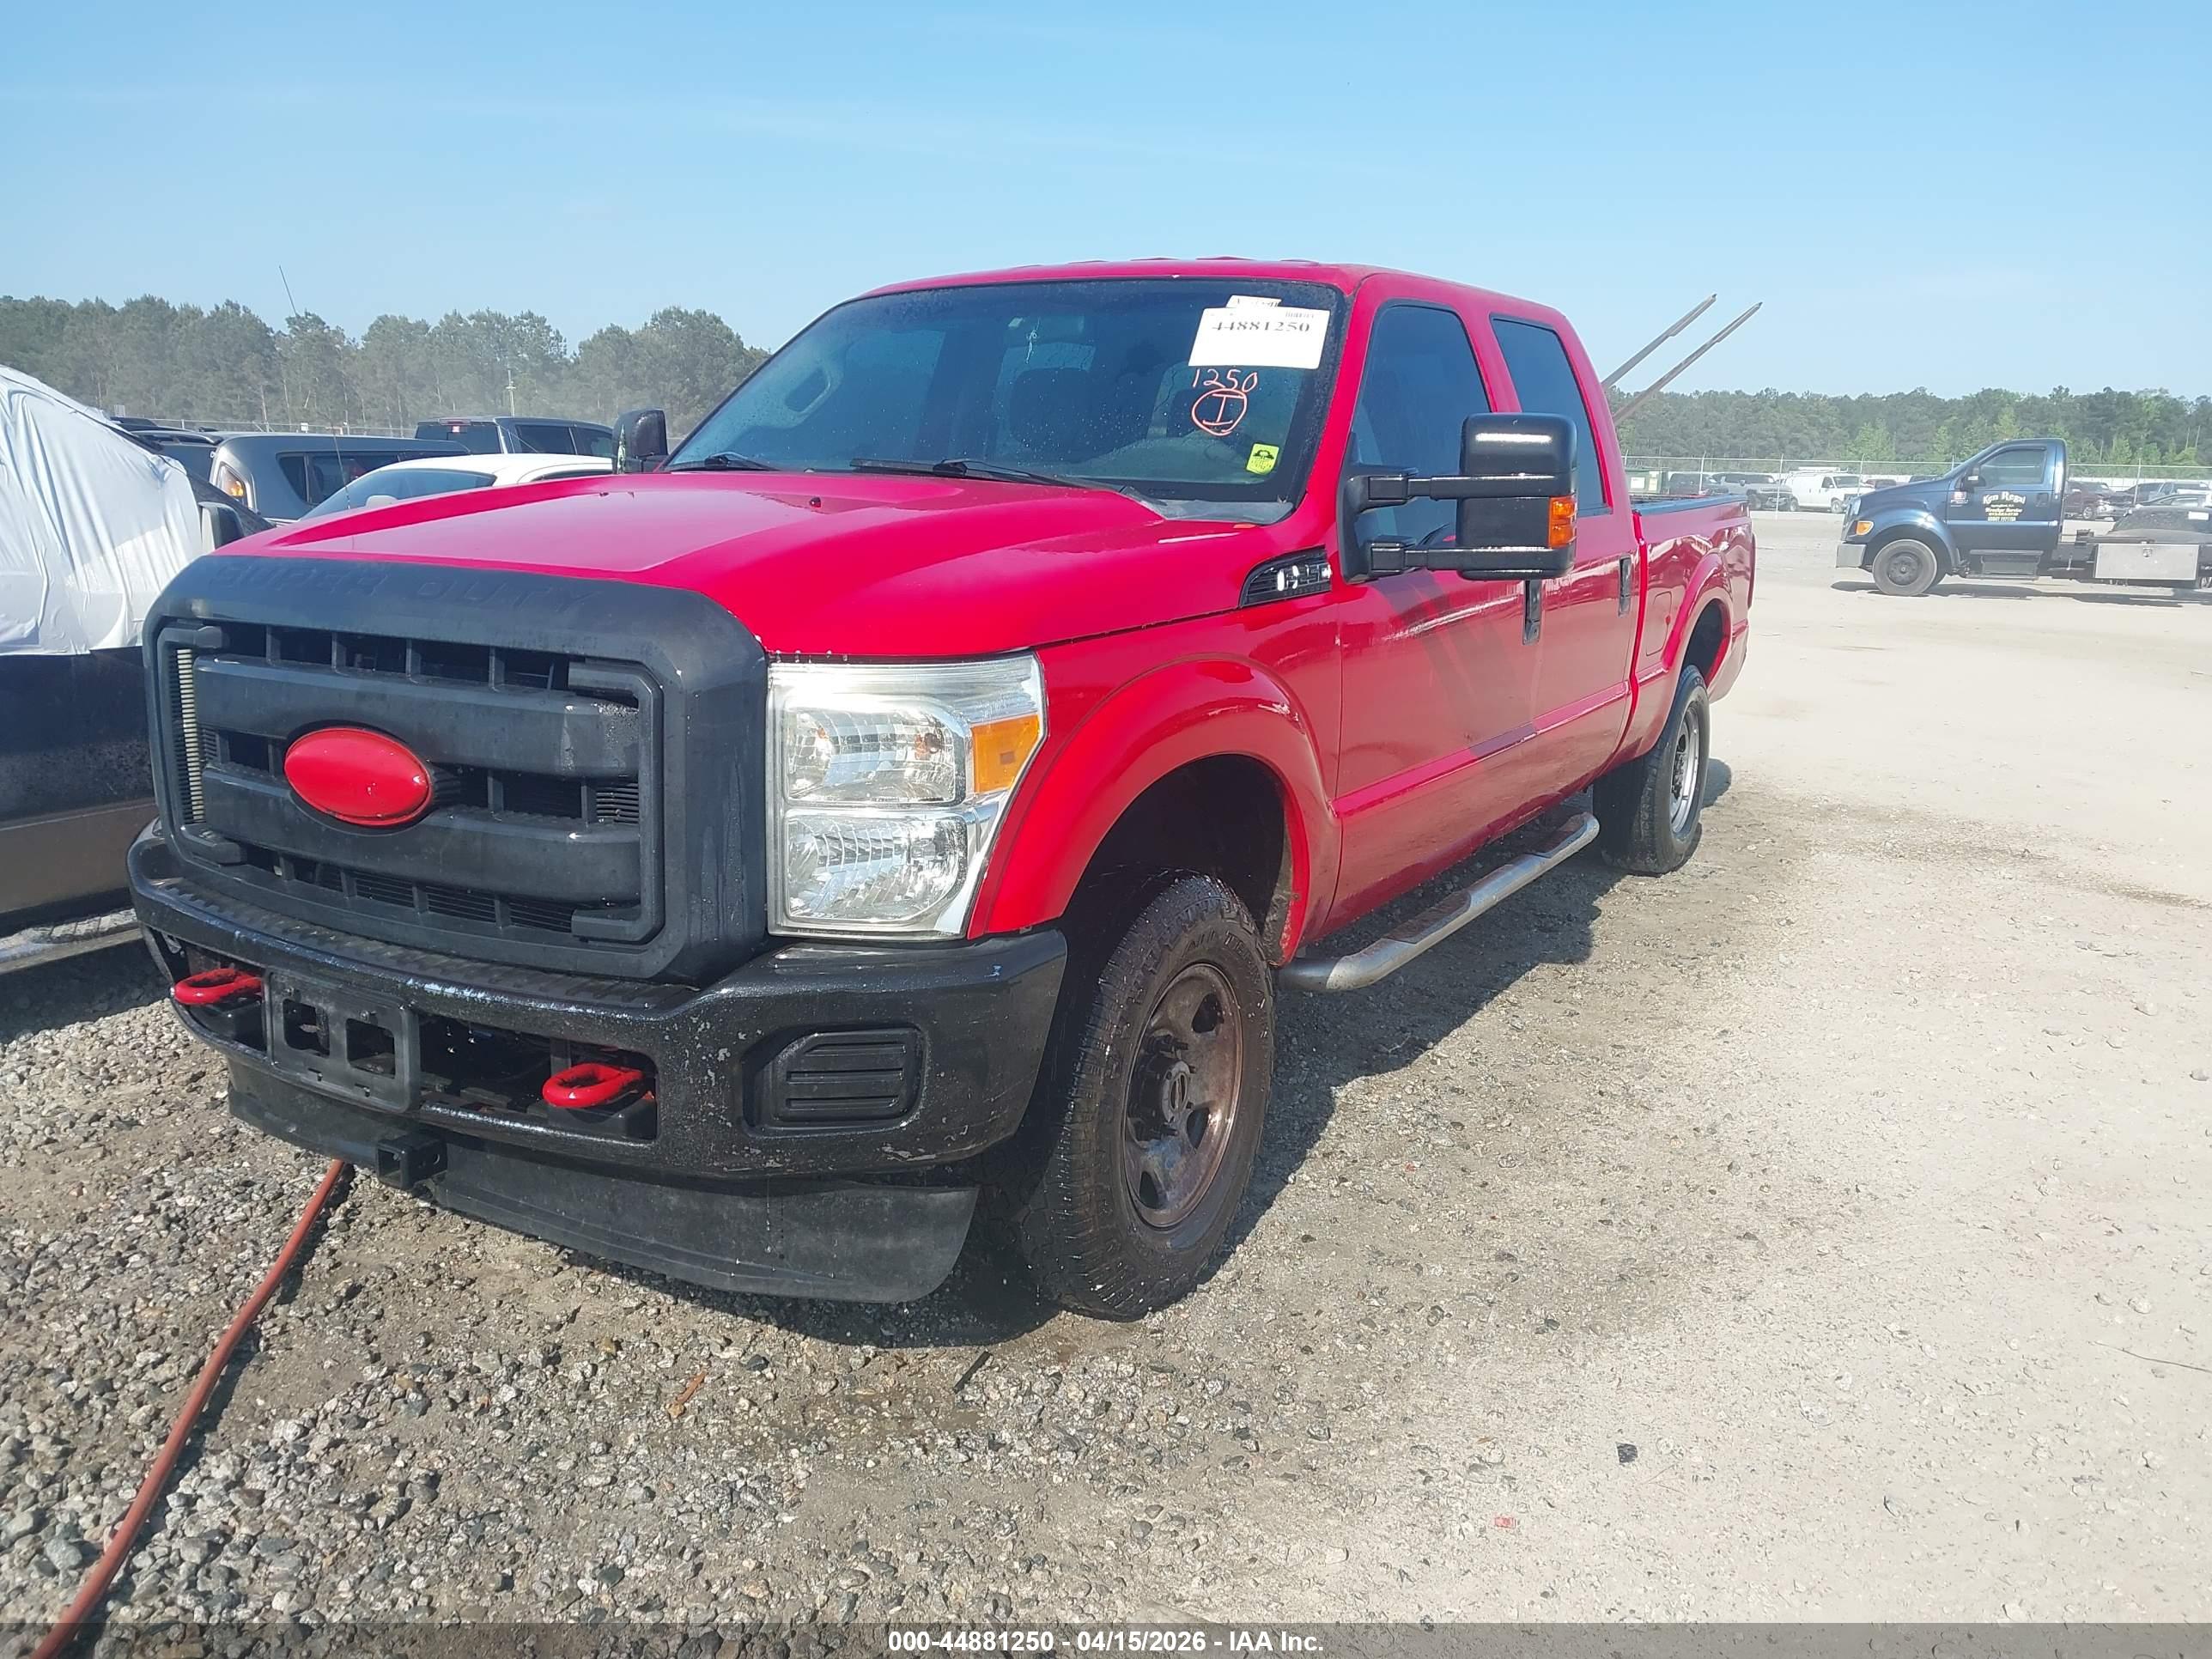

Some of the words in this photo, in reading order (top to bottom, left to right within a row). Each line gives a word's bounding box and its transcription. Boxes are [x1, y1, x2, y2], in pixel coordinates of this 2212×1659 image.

[1212, 320, 1311, 332] 44881250
[1192, 368, 1259, 393] 1250
[1983, 494, 1999, 504] Ken
[211, 561, 389, 598] SUPER
[416, 575, 602, 612] DUTY
